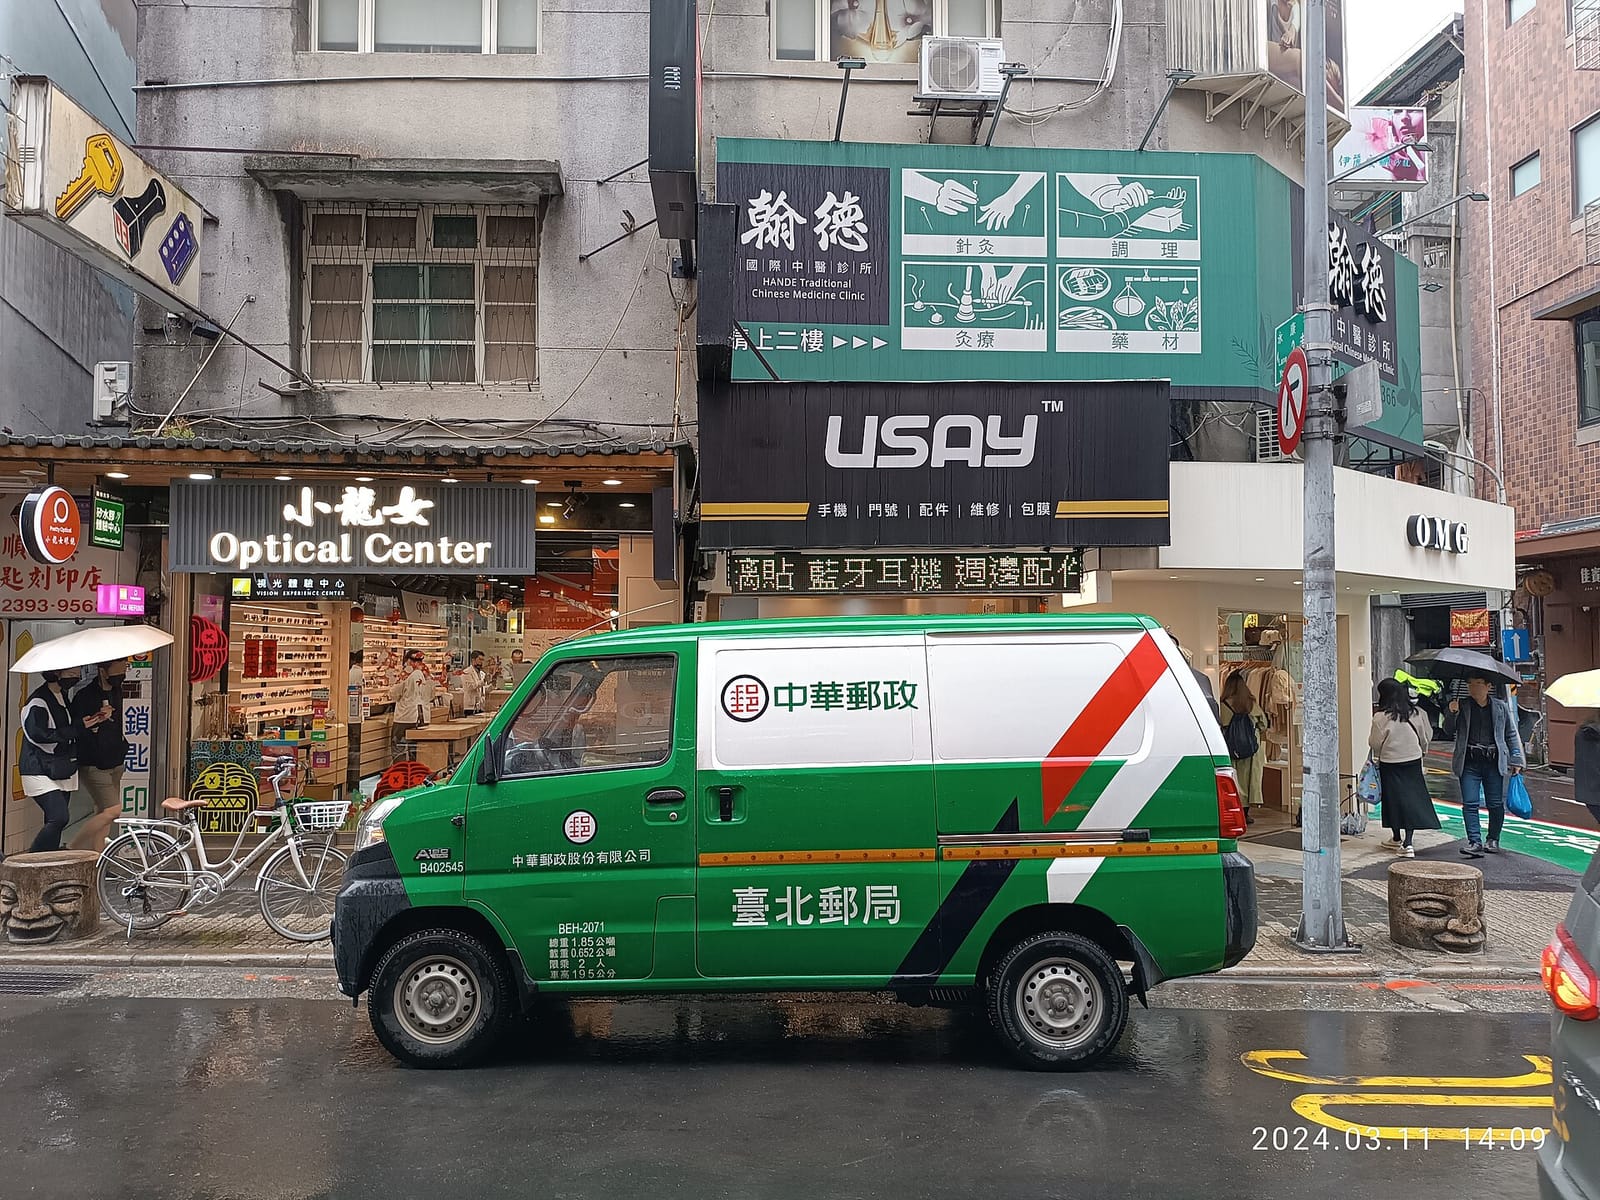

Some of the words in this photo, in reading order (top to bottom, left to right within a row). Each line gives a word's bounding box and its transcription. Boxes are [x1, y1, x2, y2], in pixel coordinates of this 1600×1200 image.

[741, 188, 869, 252] 翰德
[955, 238, 995, 255] 針灸
[1111, 240, 1179, 258] 調理
[746, 259, 873, 275] 國際中醫診所
[763, 277, 798, 288] HANDE
[799, 278, 852, 289] Traditional
[752, 288, 790, 299] Chinese
[793, 289, 837, 300] Medicine
[839, 290, 866, 301] Clinic
[955, 330, 995, 349] 灸療
[1111, 332, 1180, 351] 藥材
[825, 414, 1038, 469] USAY
[283, 485, 435, 528] 小龍女
[817, 502, 848, 518] 手機
[868, 502, 898, 518] 門號
[919, 502, 949, 518] 配件
[970, 502, 1000, 518] 維修
[1021, 501, 1051, 518] 包膜
[1413, 513, 1470, 555] OMG
[209, 532, 353, 570] Optical
[364, 532, 492, 565] Center
[807, 557, 942, 592] 藍牙耳機
[2, 598, 98, 613] 2393-956
[773, 680, 920, 713] 中華郵政
[420, 861, 464, 874] B402545
[512, 849, 652, 868] 中華郵政股份有限公司
[731, 885, 901, 927] 臺北郵局
[558, 921, 605, 935] BEH-2071
[571, 936, 594, 947] 1.85
[570, 947, 594, 958] 0.652
[578, 959, 585, 969] 2
[596, 958, 605, 968] 人
